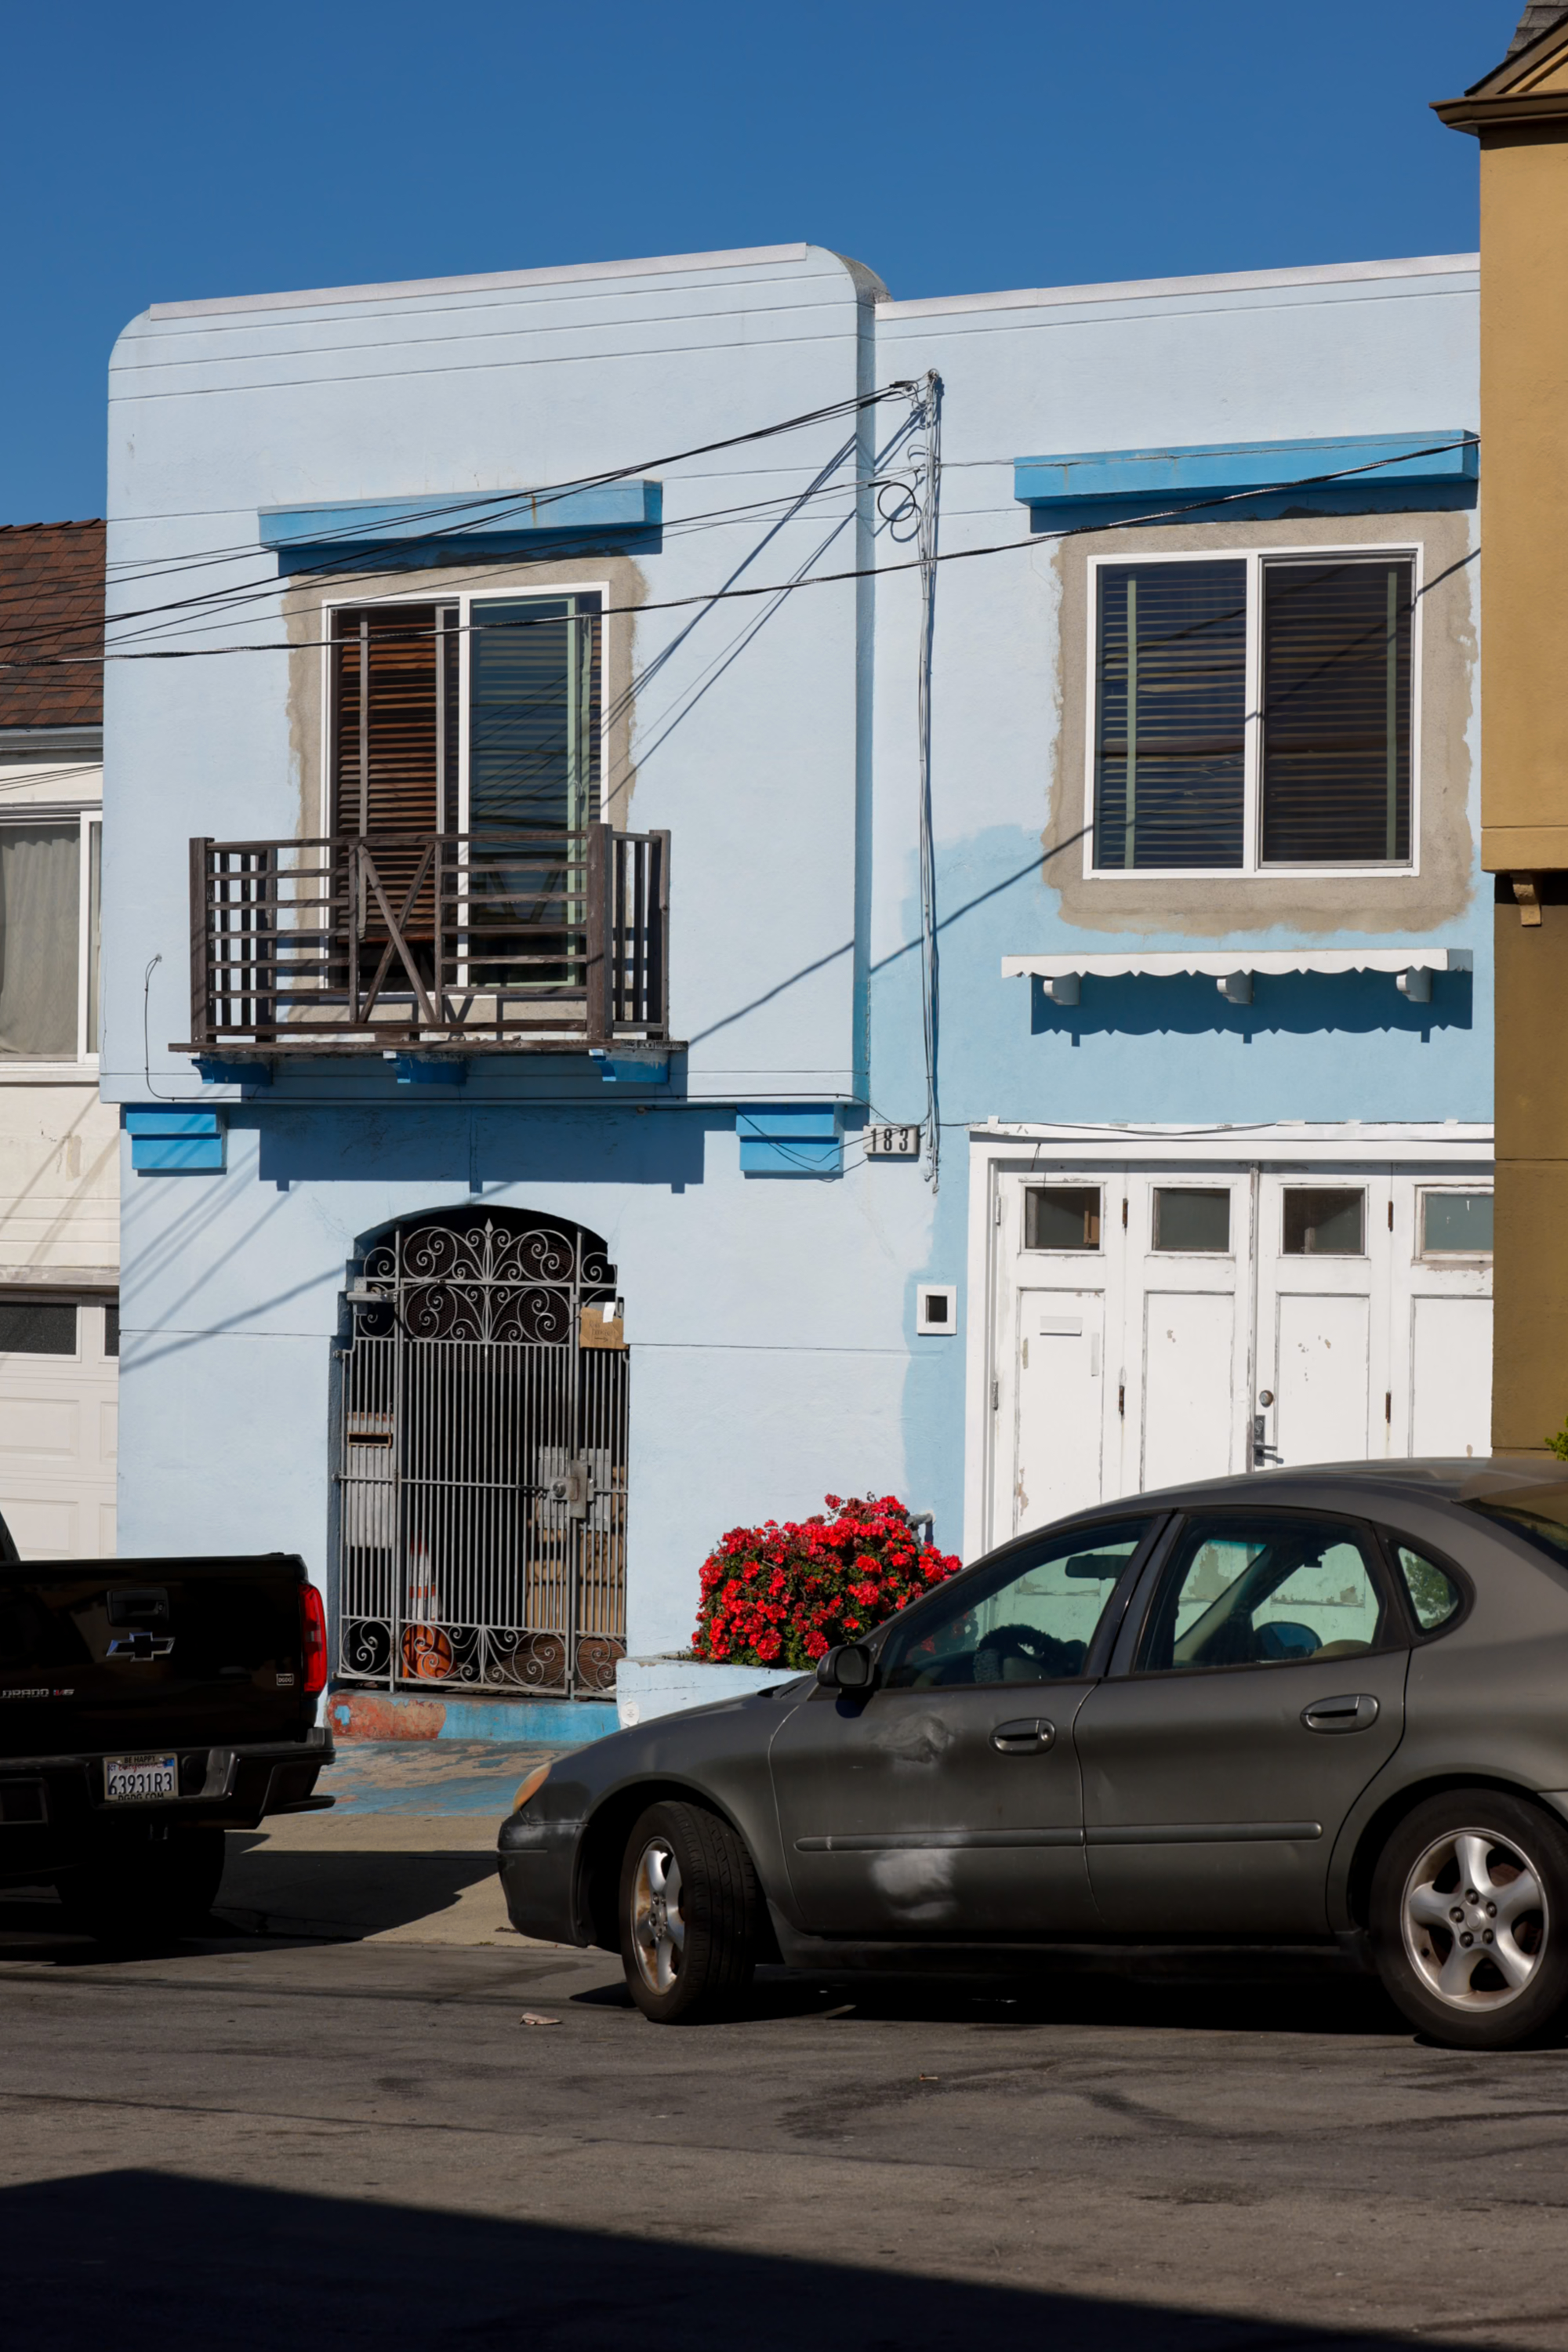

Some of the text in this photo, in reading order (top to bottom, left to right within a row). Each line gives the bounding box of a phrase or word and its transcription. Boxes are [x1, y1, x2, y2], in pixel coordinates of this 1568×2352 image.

[870, 1127, 909, 1152] 183
[108, 1772, 172, 1795] 63931R3
[118, 1792, 164, 1801] DGDGCOM
